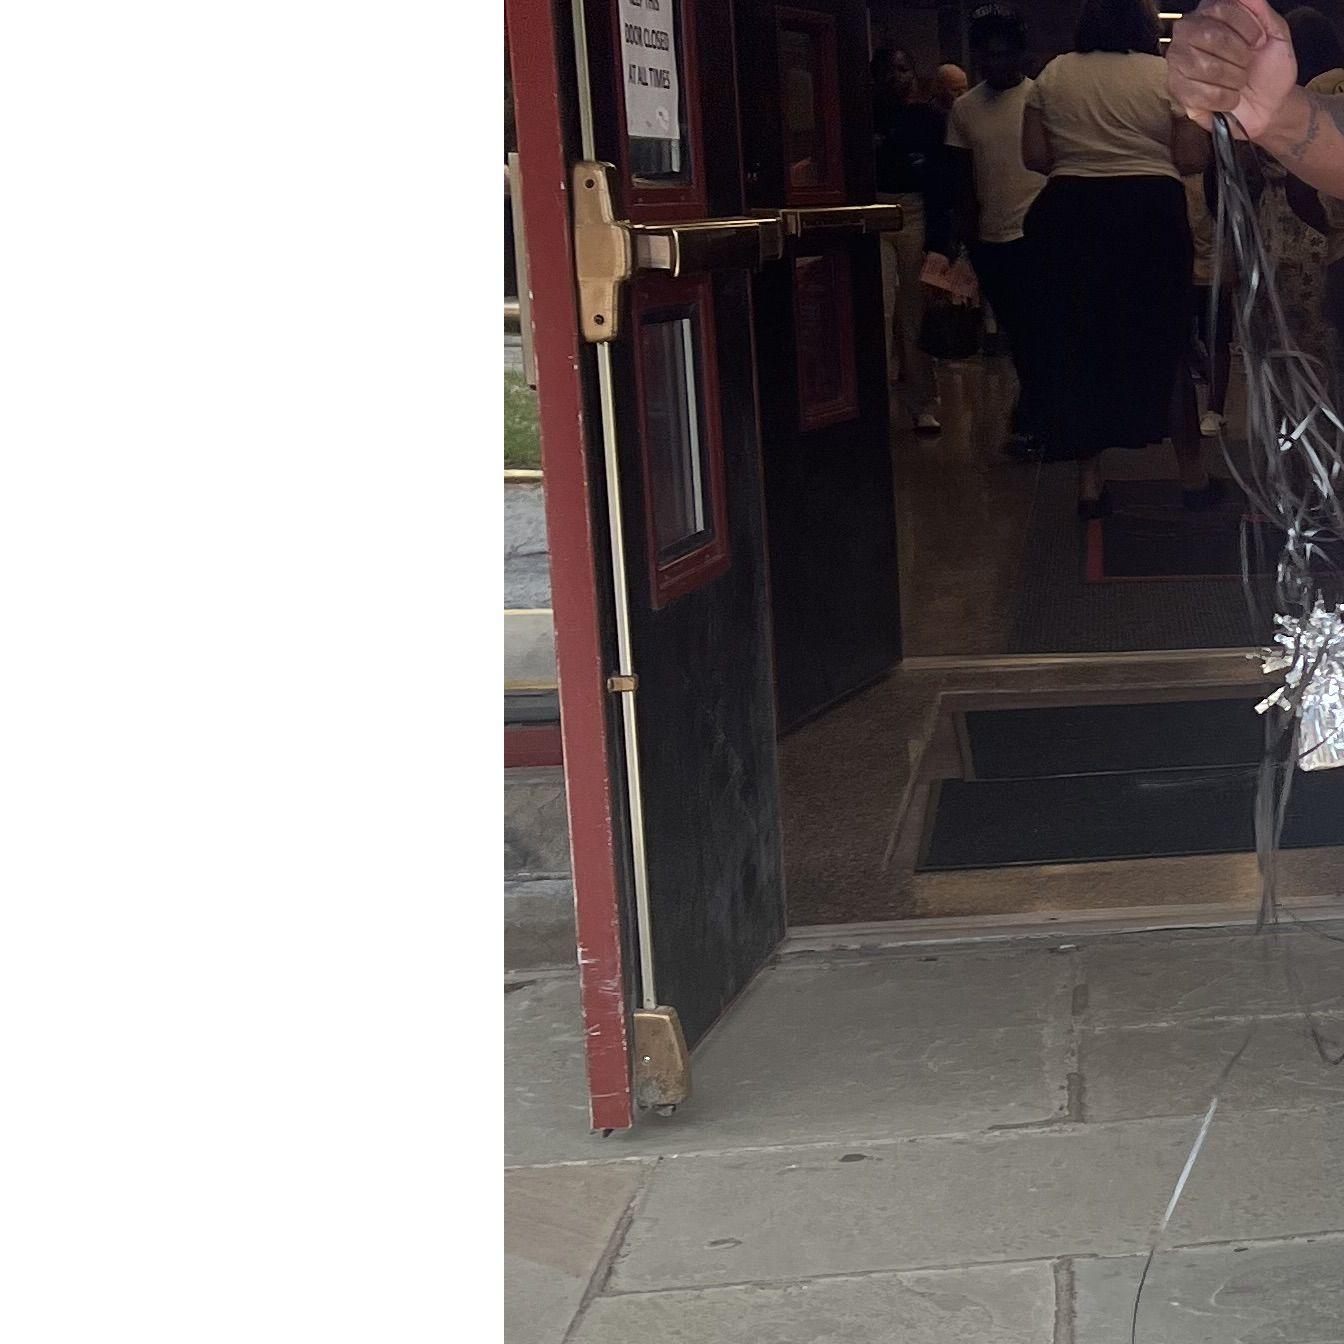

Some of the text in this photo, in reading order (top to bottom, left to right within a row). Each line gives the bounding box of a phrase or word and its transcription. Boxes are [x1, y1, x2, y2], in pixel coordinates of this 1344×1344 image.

[624, 22, 670, 52] DOOR CLOSED
[628, 64, 671, 90] AT ALL TIMES
